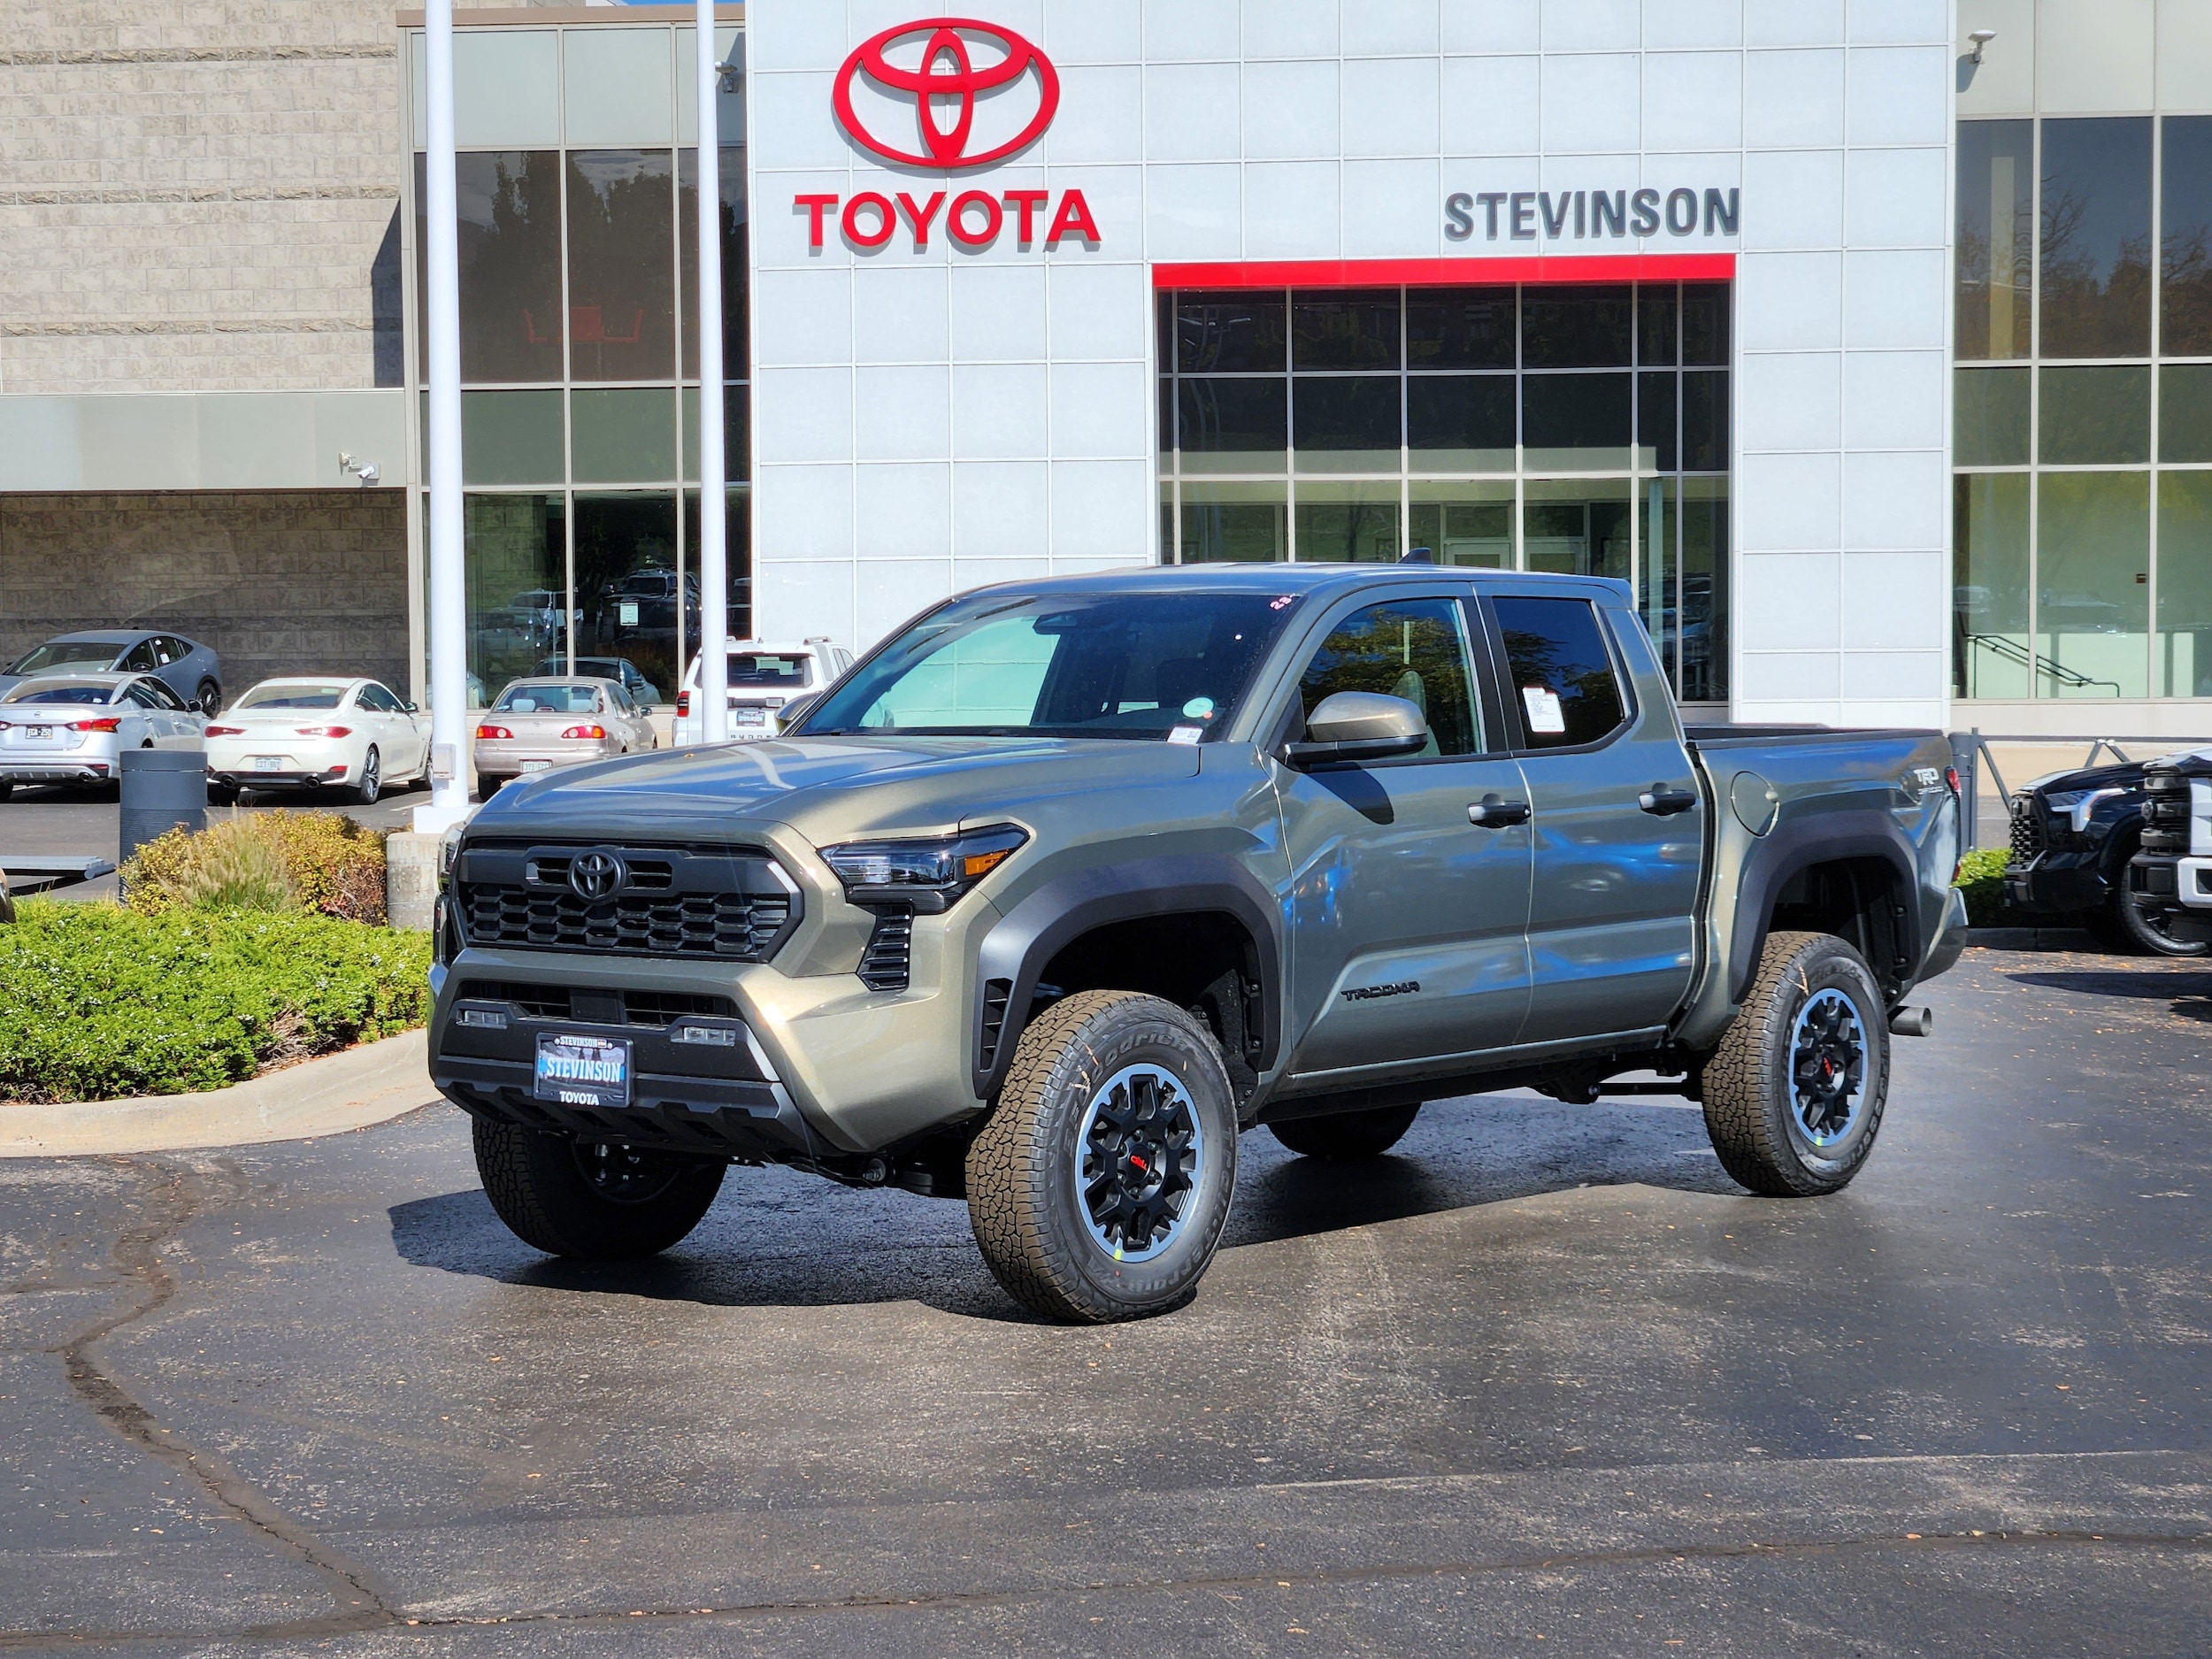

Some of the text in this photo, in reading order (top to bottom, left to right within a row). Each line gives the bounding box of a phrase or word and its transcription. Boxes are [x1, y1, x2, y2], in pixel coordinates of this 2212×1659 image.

[794, 188, 1102, 247] TOYOTA
[1444, 188, 1740, 242] STEVINSON
[1913, 767, 1939, 786] TRD
[1340, 980, 1420, 1002] TACOMA
[560, 1036, 598, 1048] STEVINSON
[546, 1056, 623, 1083] STEVINSON
[559, 1090, 600, 1106] TOYOTA
